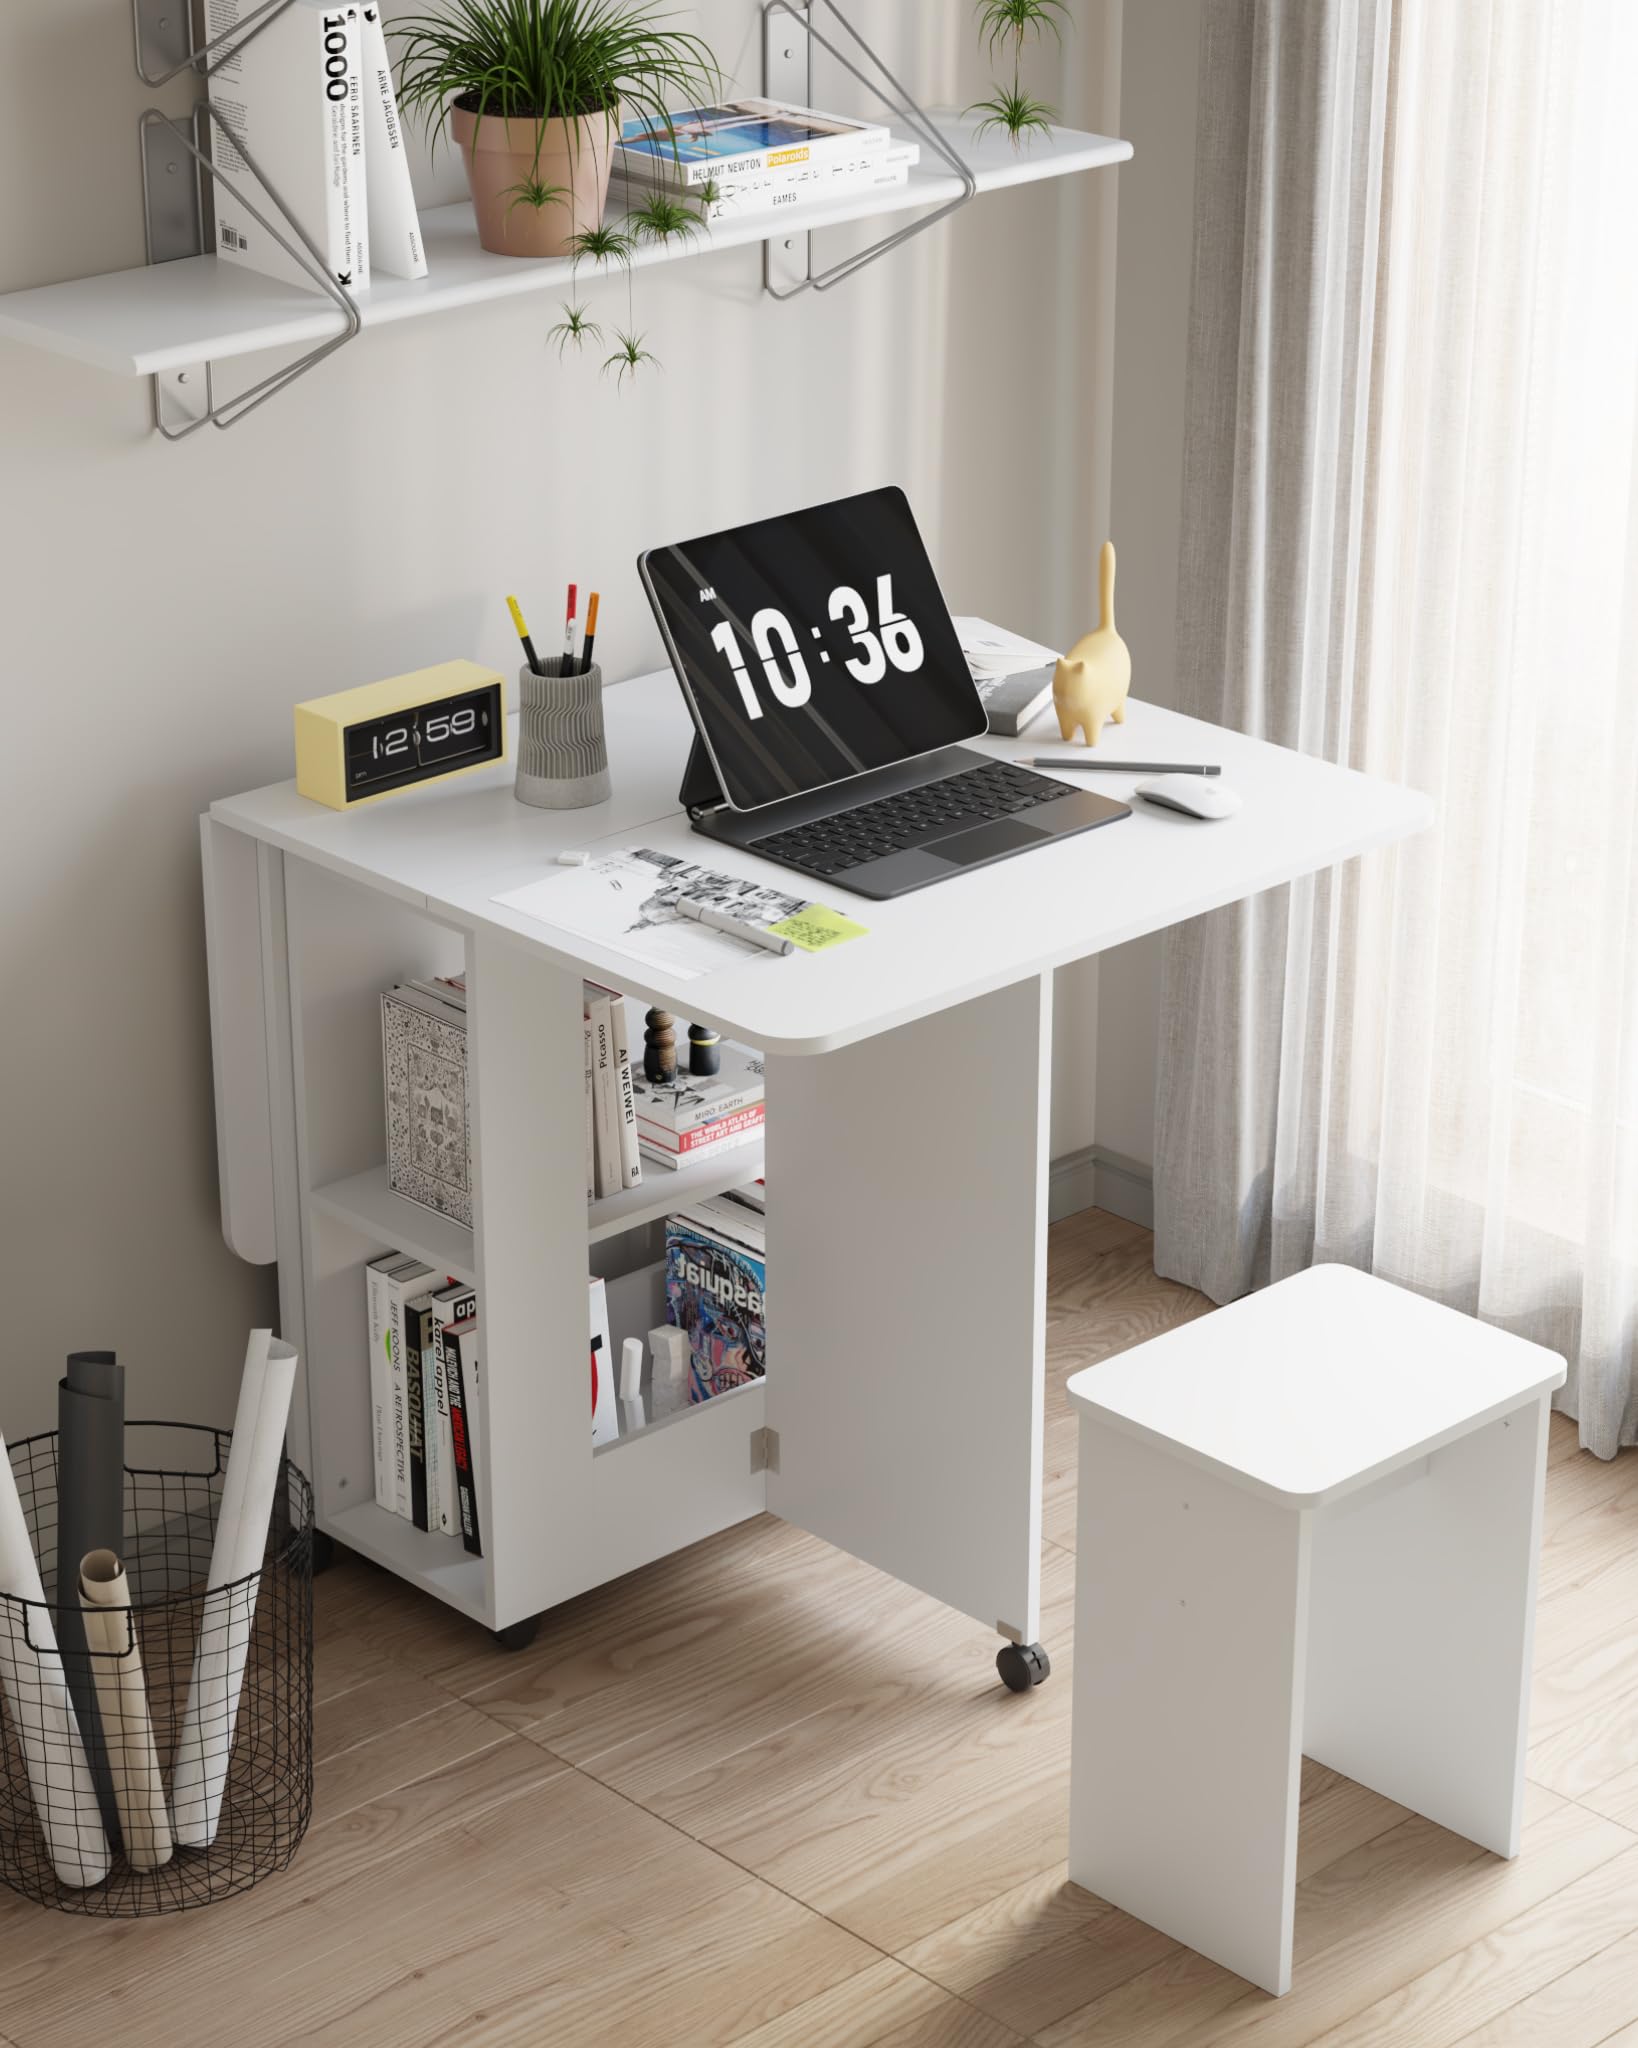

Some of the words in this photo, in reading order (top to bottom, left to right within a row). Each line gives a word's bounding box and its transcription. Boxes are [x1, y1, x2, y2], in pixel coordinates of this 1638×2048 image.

[324, 14, 349, 101] 1000
[376, 70, 390, 96] ARNE
[350, 105, 361, 155] SAARINEN
[382, 99, 400, 149] JACOBSEN
[692, 163, 726, 181] HELMUT
[727, 157, 761, 173] NEWTON
[767, 147, 810, 166] Polaroids
[773, 192, 797, 205] EAMES
[344, 231, 352, 246] find
[344, 246, 352, 264] them
[700, 586, 717, 602] AM
[426, 709, 475, 742] 59
[598, 1024, 608, 1069] Picasso
[619, 1049, 629, 1064] AI
[621, 1067, 635, 1125] WEIWEI
[718, 1097, 744, 1111] EARTH
[690, 1128, 705, 1141] THE
[703, 1120, 728, 1136] WORLD
[727, 1113, 749, 1128] ATLAS
[748, 1109, 758, 1119] OF
[690, 1134, 716, 1149] STREET
[715, 1127, 729, 1139] ART
[728, 1122, 743, 1134] AND
[631, 1164, 640, 1178] RA
[391, 1327, 401, 1373] KOONS
[434, 1316, 446, 1364] karel
[445, 1345, 460, 1381] MALEVICH
[394, 1382, 402, 1391] A
[434, 1364, 448, 1417] appel
[448, 1376, 461, 1395] AND
[405, 1346, 423, 1464] BASQUIAT
[449, 1390, 462, 1409] THE
[393, 1394, 406, 1483] RETROSPECTIVE
